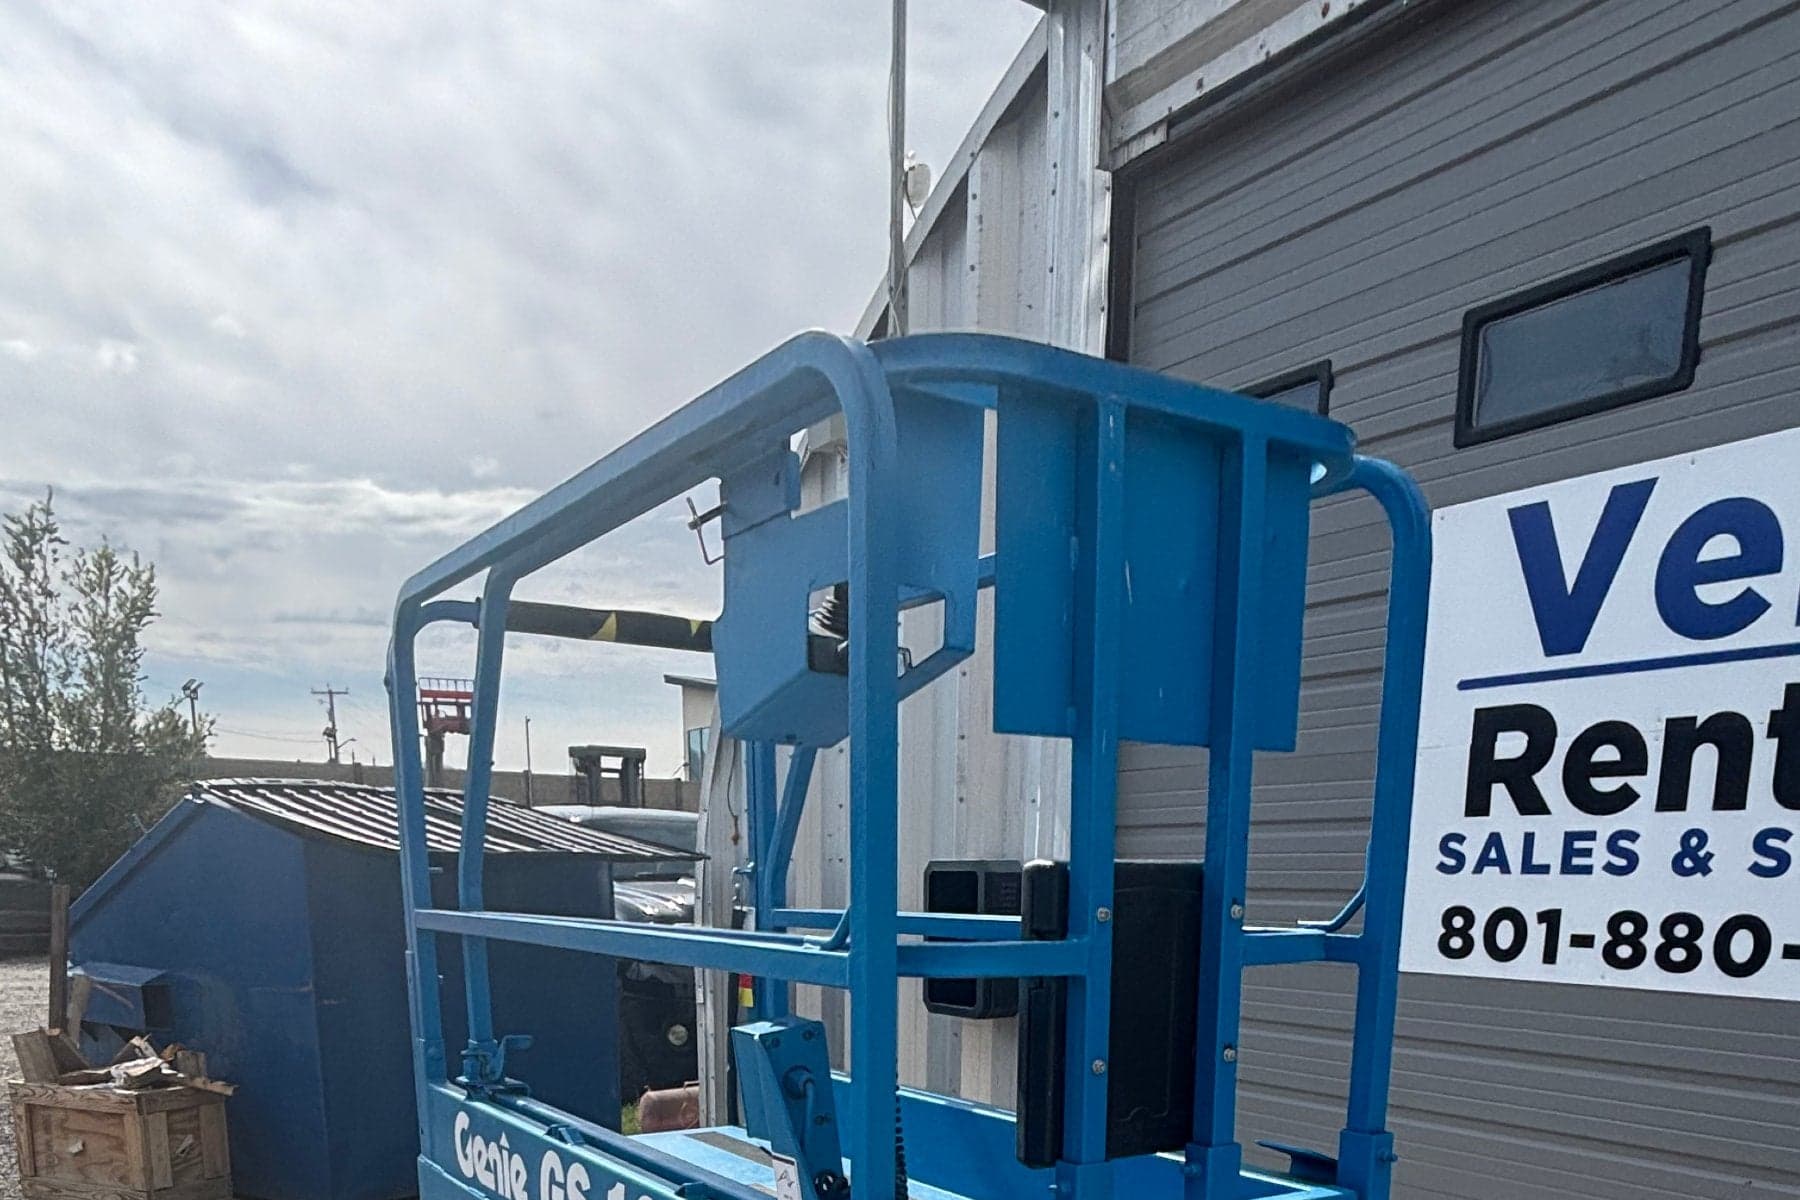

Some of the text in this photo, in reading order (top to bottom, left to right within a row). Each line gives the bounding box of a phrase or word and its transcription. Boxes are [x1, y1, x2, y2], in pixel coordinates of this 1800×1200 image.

[1507, 477, 1800, 658] Ve
[1436, 830, 1641, 877] SALES
[1671, 828, 1715, 877] &
